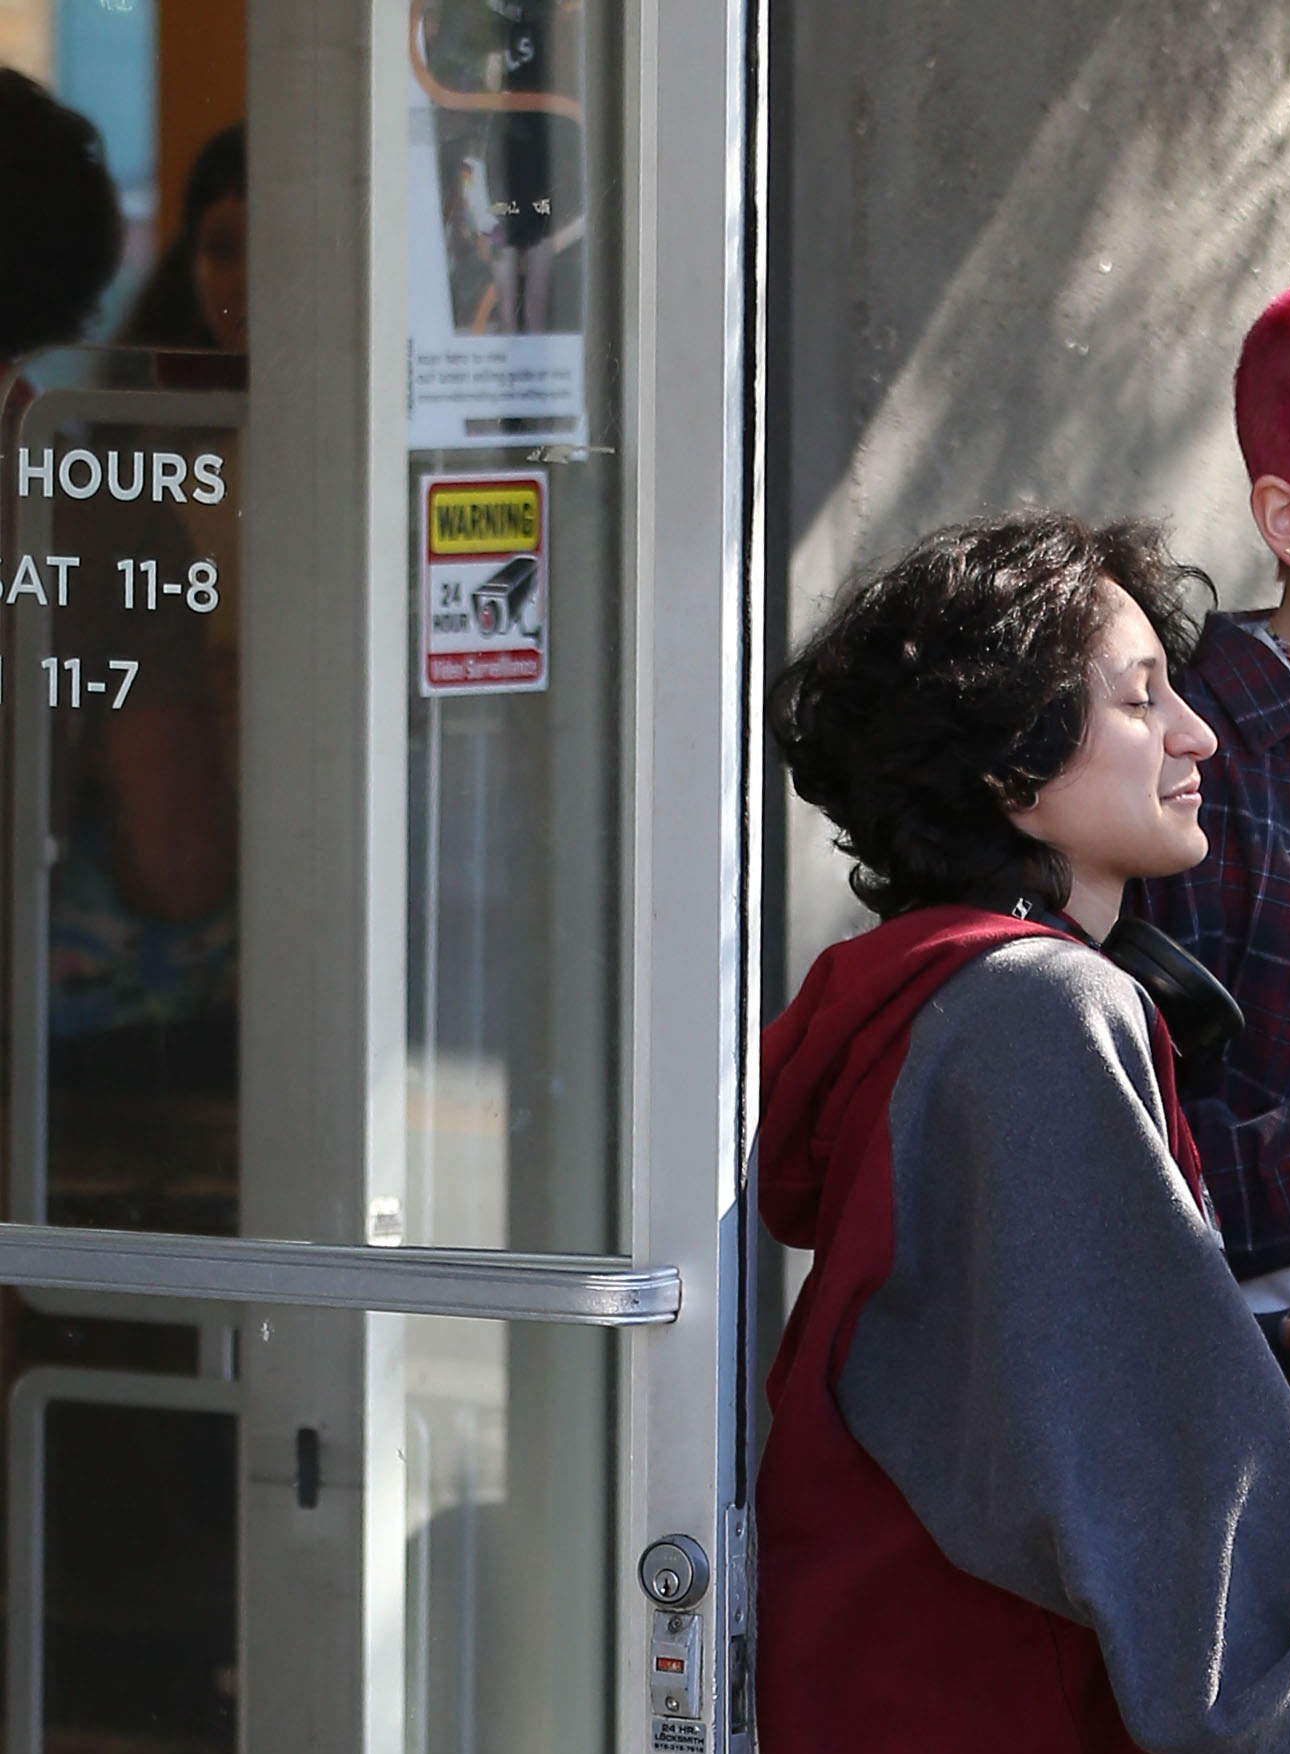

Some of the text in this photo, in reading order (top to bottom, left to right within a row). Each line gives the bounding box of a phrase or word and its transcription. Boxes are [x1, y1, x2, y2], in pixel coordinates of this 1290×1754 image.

[18, 447, 226, 505] HOURS
[437, 503, 534, 540] WARNING
[0, 554, 219, 613] AT 11-8
[441, 583, 461, 608] 24
[433, 613, 468, 633] HOUR
[41, 657, 140, 709] 11-7
[655, 1733, 705, 1745] LOCKSMITH
[662, 1724, 676, 1732] 24
